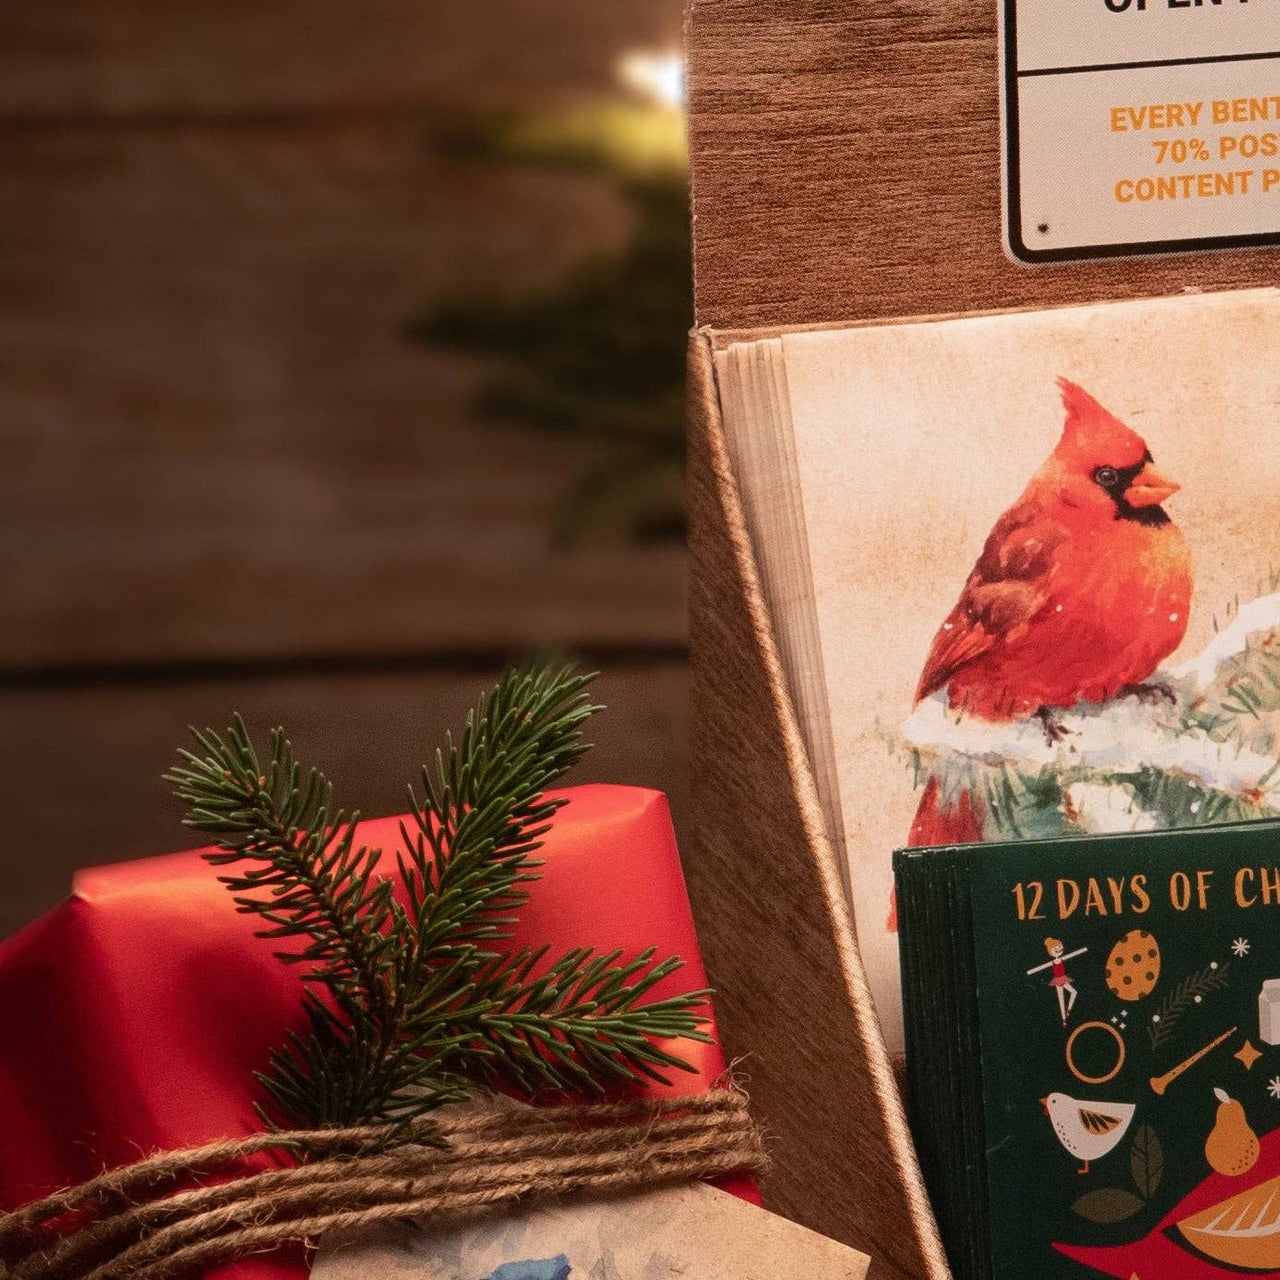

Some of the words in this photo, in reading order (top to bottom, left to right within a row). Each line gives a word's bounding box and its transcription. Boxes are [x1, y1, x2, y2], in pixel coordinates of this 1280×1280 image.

[1110, 102, 1203, 132] EVERY
[1153, 138, 1209, 165] 70%
[1114, 170, 1253, 204] CONTENT
[1012, 881, 1046, 920] 12
[1056, 874, 1151, 920] DAYS
[1169, 870, 1215, 911] OF
